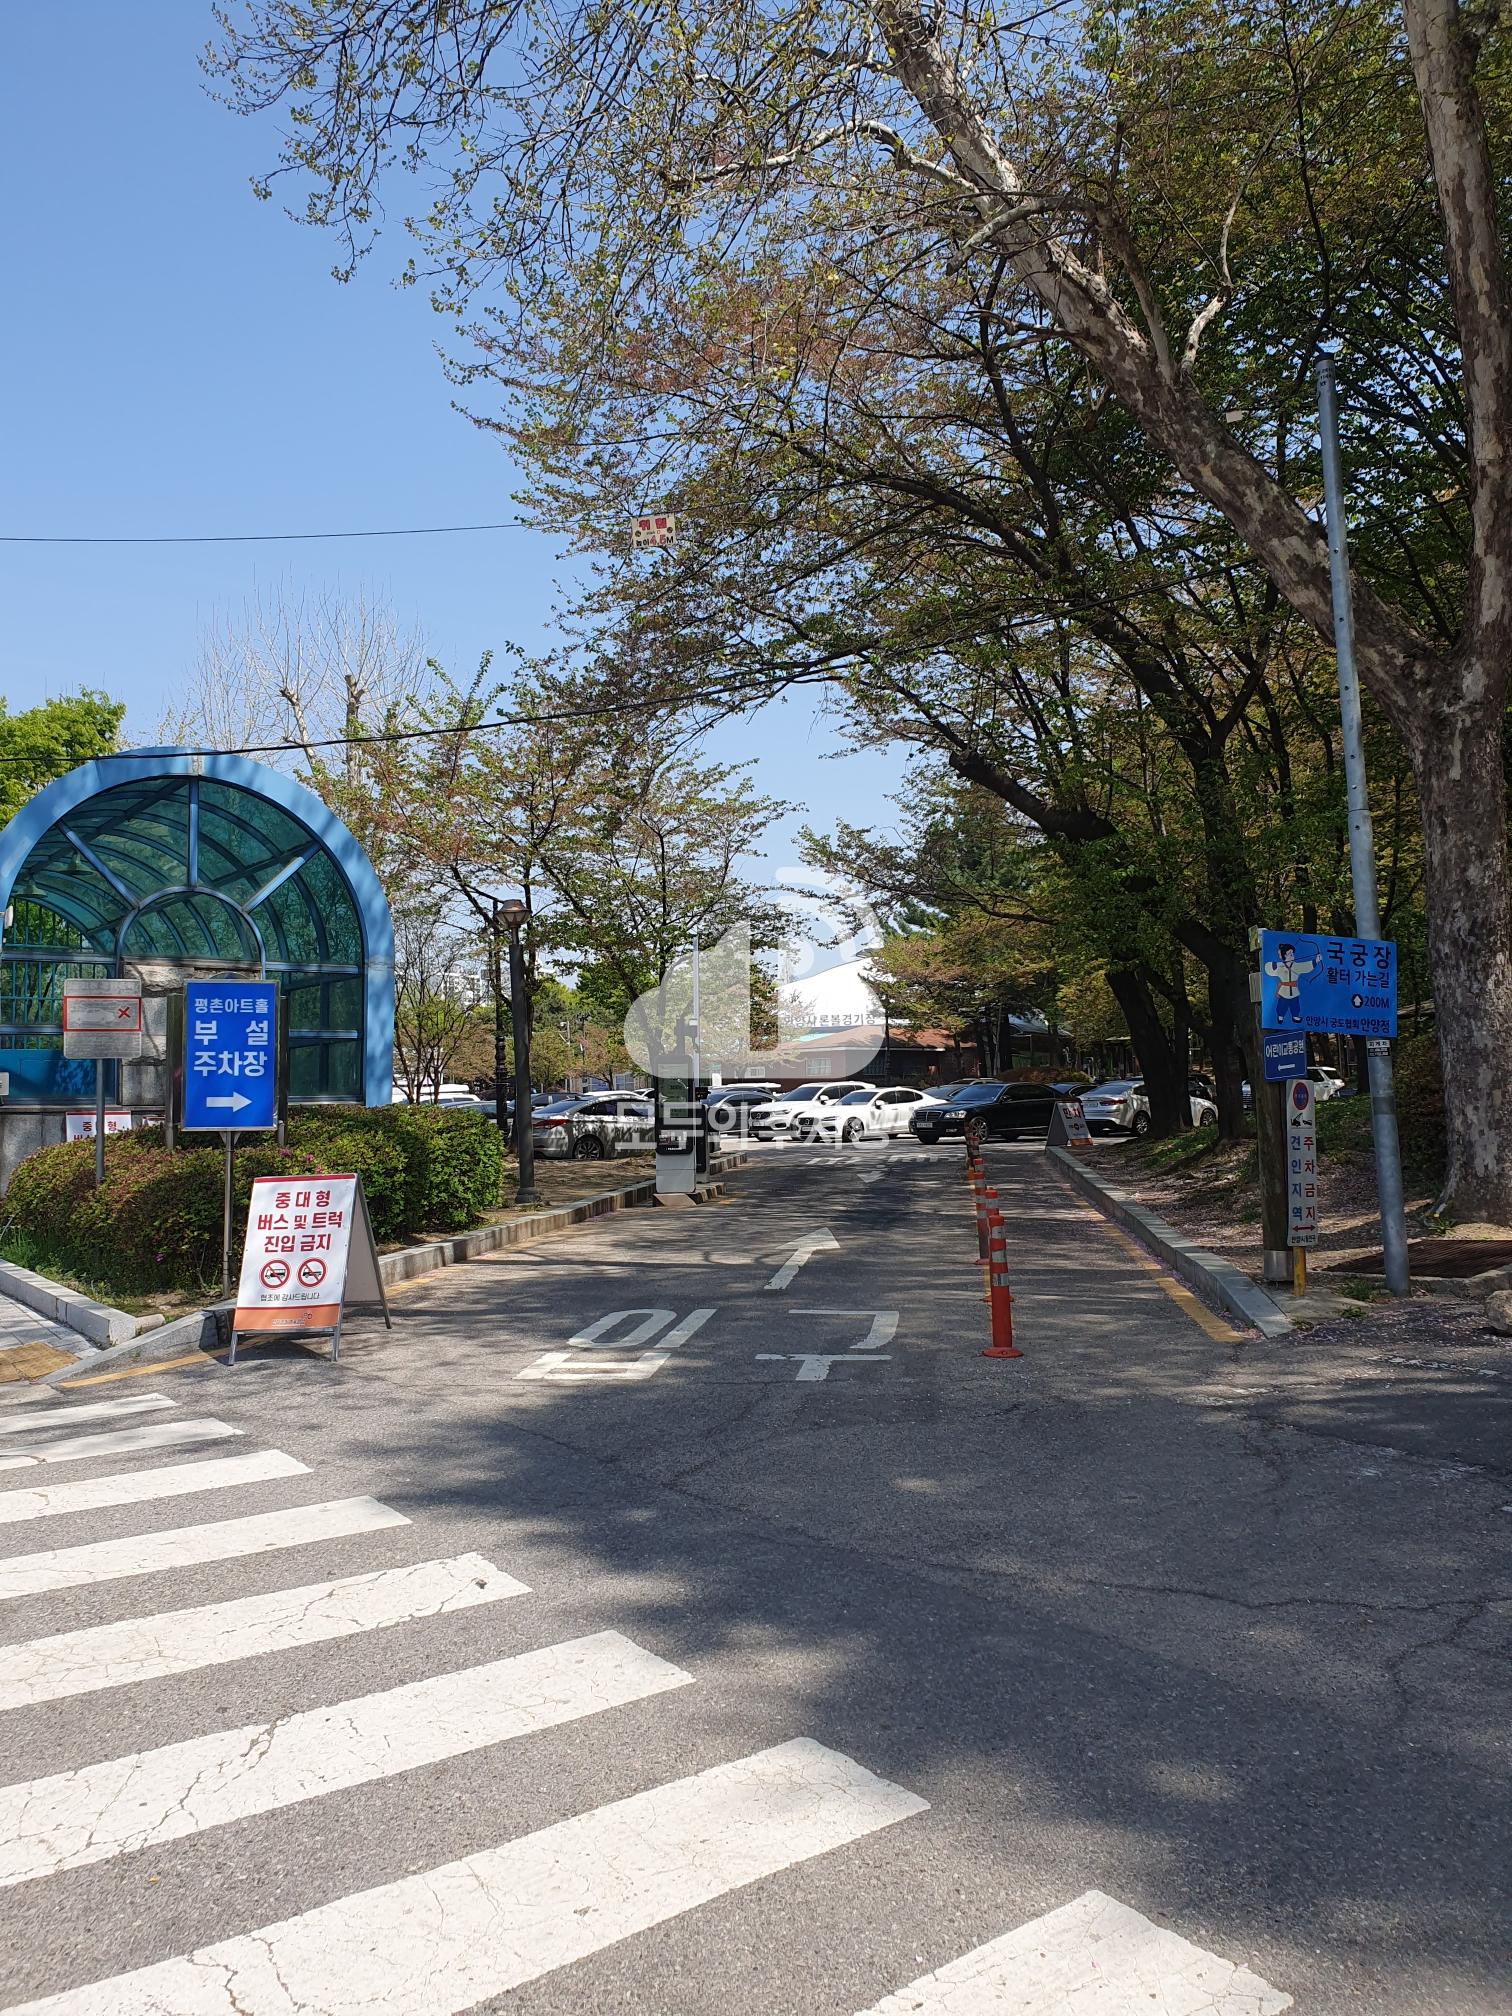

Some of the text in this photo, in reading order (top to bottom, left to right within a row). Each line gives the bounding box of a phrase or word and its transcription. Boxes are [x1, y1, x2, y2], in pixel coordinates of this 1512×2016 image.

[1354, 969, 1390, 988] 가는길
[194, 998, 269, 1014] 평촌아트홀
[1364, 995, 1390, 1009] 200M
[1305, 1016, 1328, 1028] 안양시
[1360, 1018, 1390, 1034] 안양정
[193, 1050, 267, 1077] 주차장
[82, 1121, 117, 1132] 중형
[257, 1210, 343, 1231] 버스 및 트럭
[263, 1233, 331, 1254] 진입 금지
